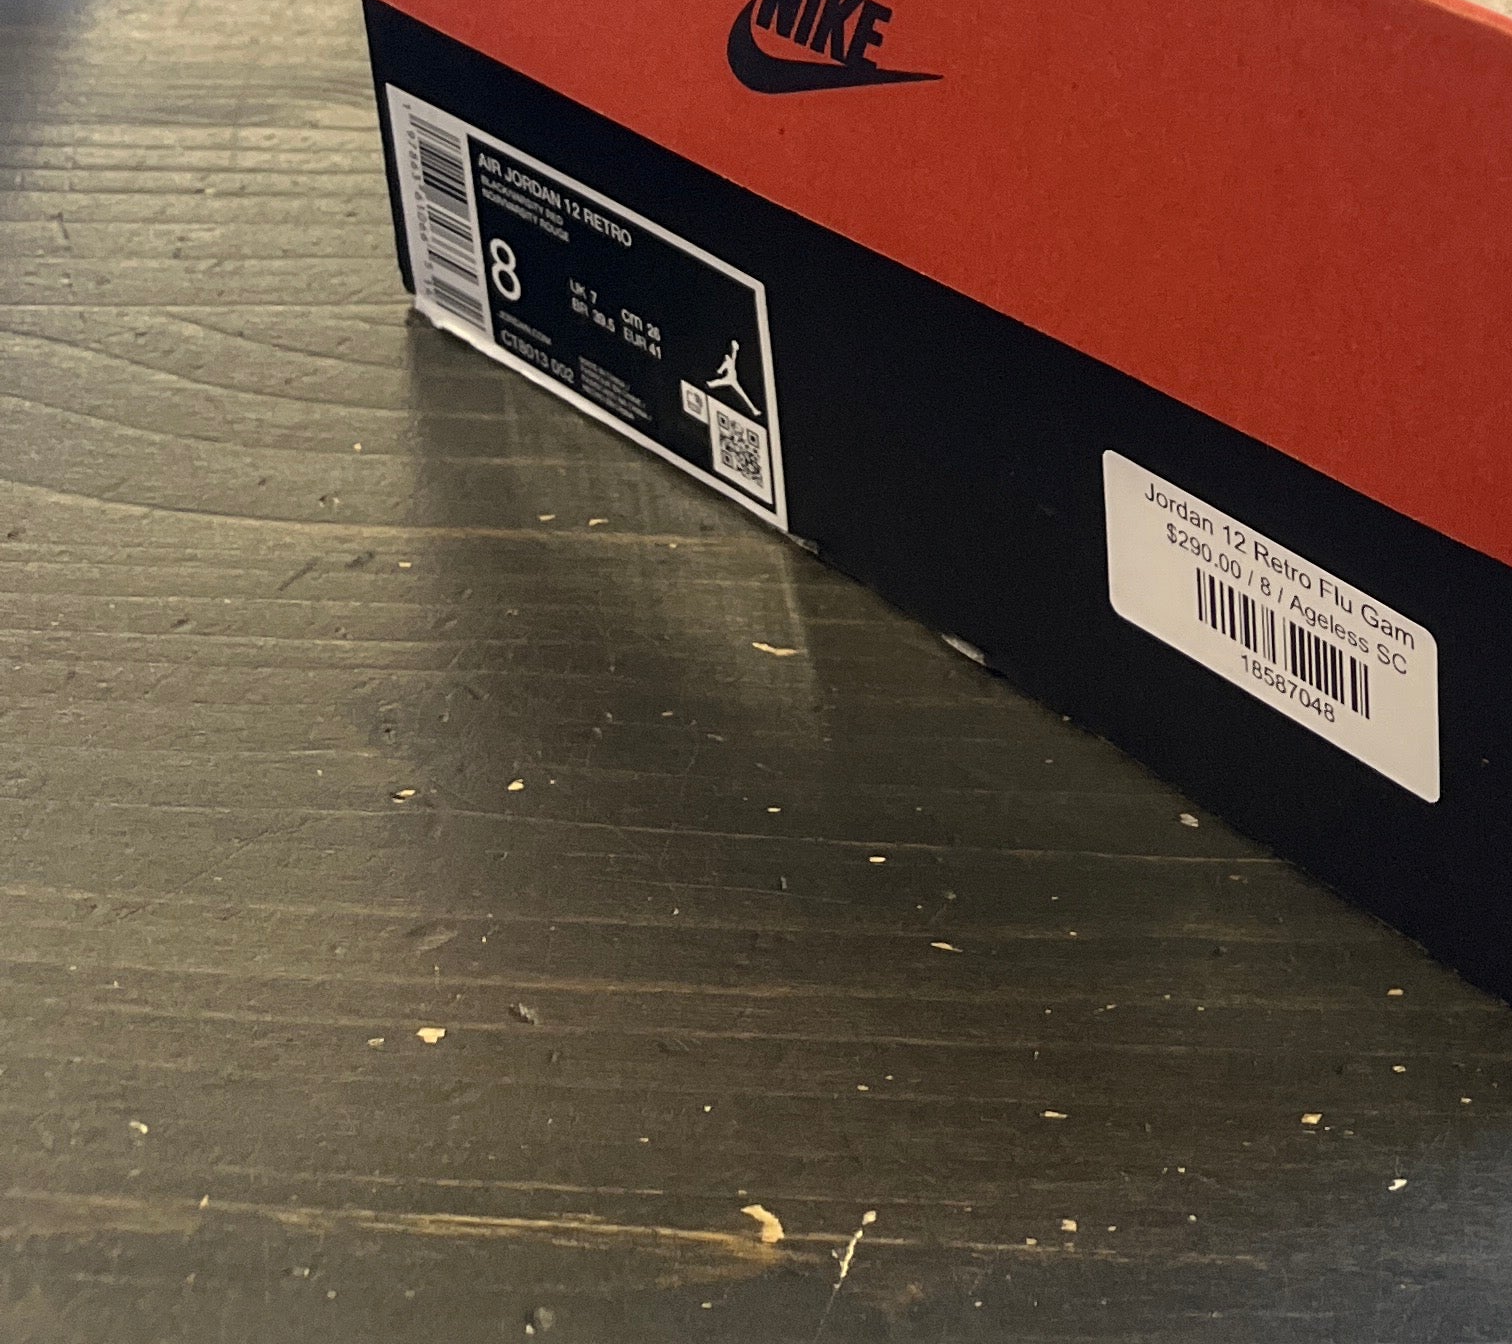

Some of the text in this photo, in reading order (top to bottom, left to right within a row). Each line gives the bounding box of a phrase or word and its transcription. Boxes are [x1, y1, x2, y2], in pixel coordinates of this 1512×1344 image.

[478, 153, 632, 247] AIR JORDAN 12 RETRO
[490, 238, 522, 301] 8
[569, 277, 598, 304] UK 7
[622, 326, 662, 360] EUR 41
[1144, 482, 1416, 650] Jordan 12 Retro Flu Gam
[1166, 522, 1242, 581] $290.00
[1259, 576, 1272, 598] 8
[1289, 593, 1370, 655] Ageless
[1375, 642, 1408, 676] SC
[1240, 653, 1337, 725] 18587048
